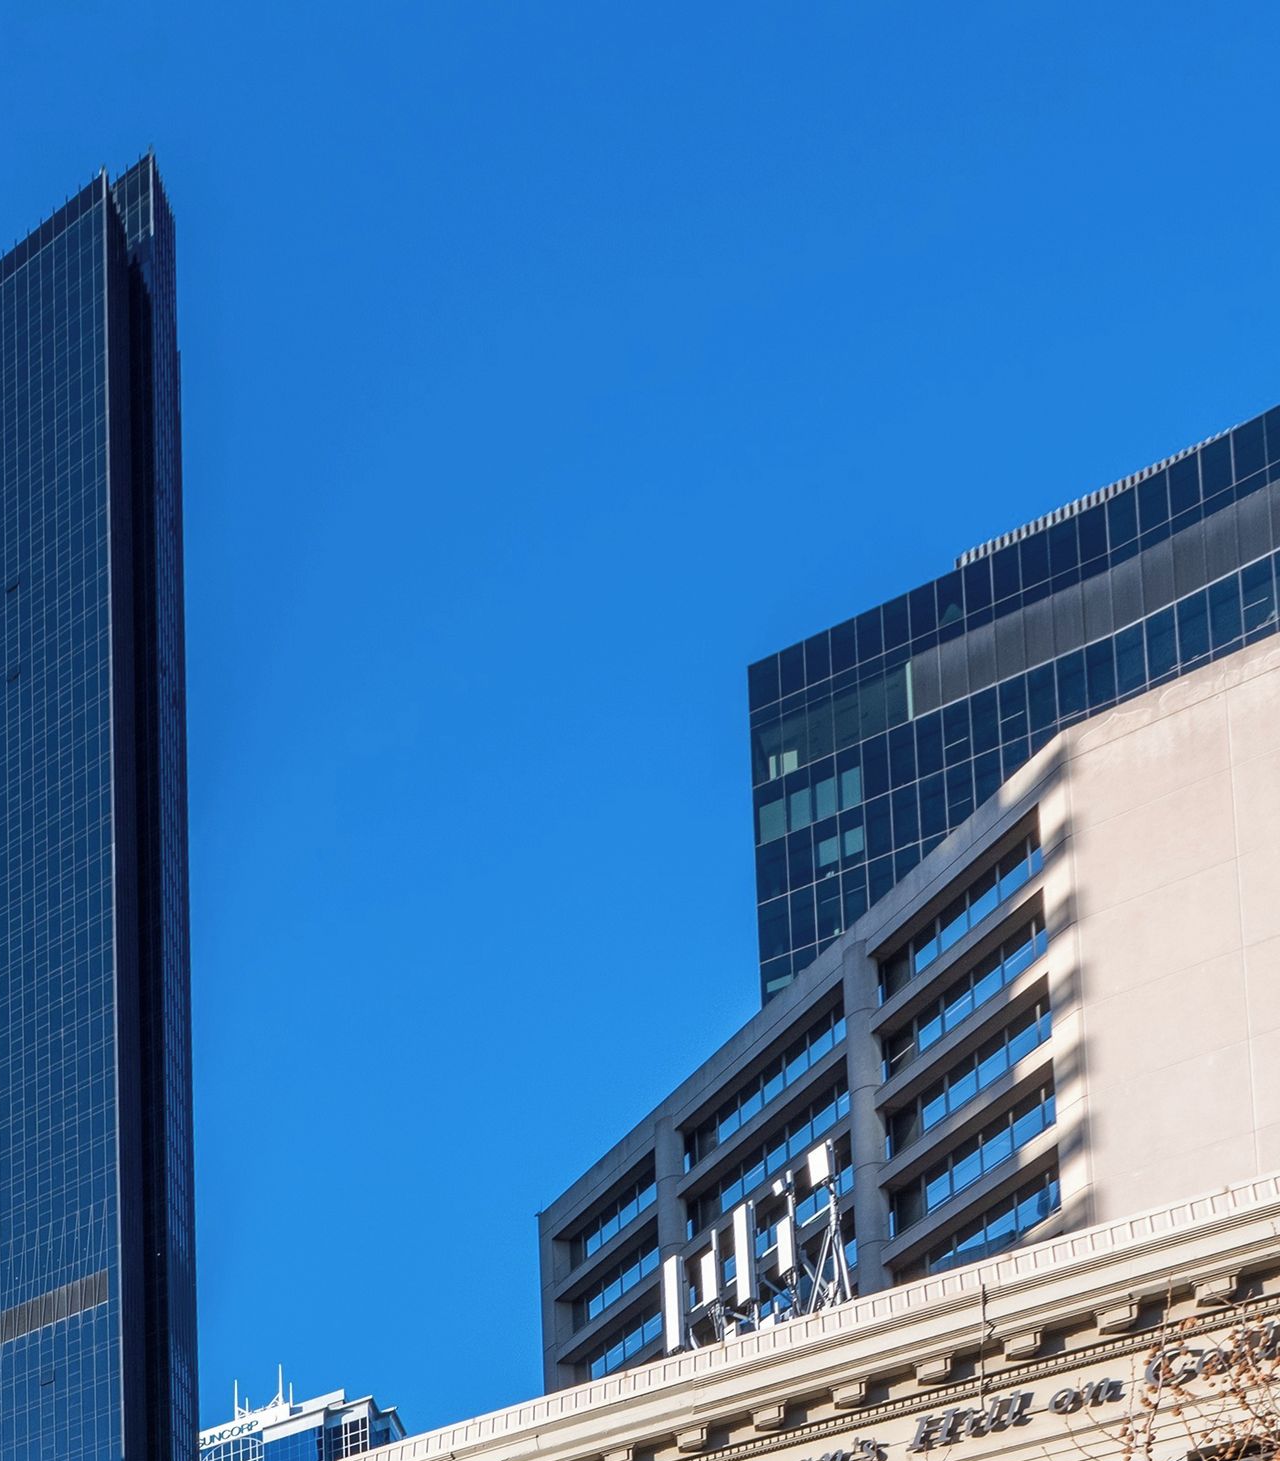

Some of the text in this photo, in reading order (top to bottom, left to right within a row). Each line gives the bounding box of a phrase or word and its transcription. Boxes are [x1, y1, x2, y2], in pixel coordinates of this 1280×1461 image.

[199, 1420, 259, 1448] SUNCORP
[907, 1388, 1027, 1451] Hill
[1048, 1376, 1118, 1414] on
